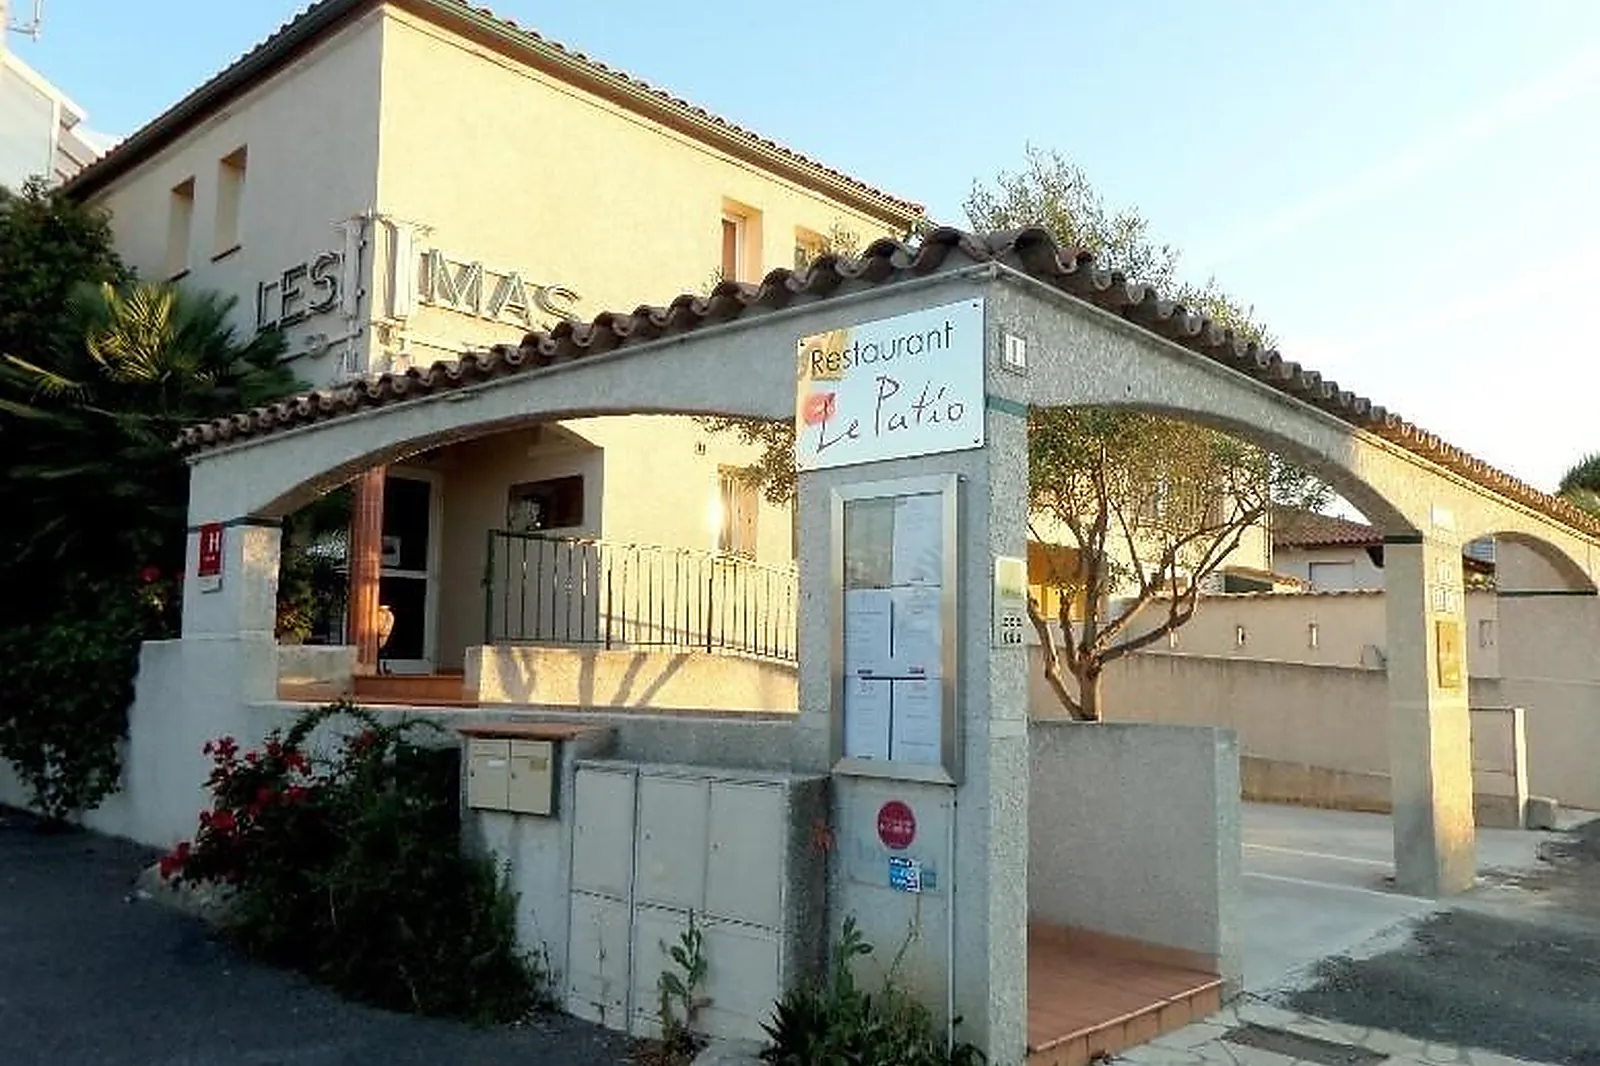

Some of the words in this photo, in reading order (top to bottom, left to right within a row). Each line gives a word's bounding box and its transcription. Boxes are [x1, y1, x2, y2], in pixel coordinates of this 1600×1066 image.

[257, 251, 341, 332] LES
[420, 248, 580, 332] MAS
[810, 320, 954, 375] Restaurant
[815, 393, 860, 453] Le
[209, 531, 220, 552] H
